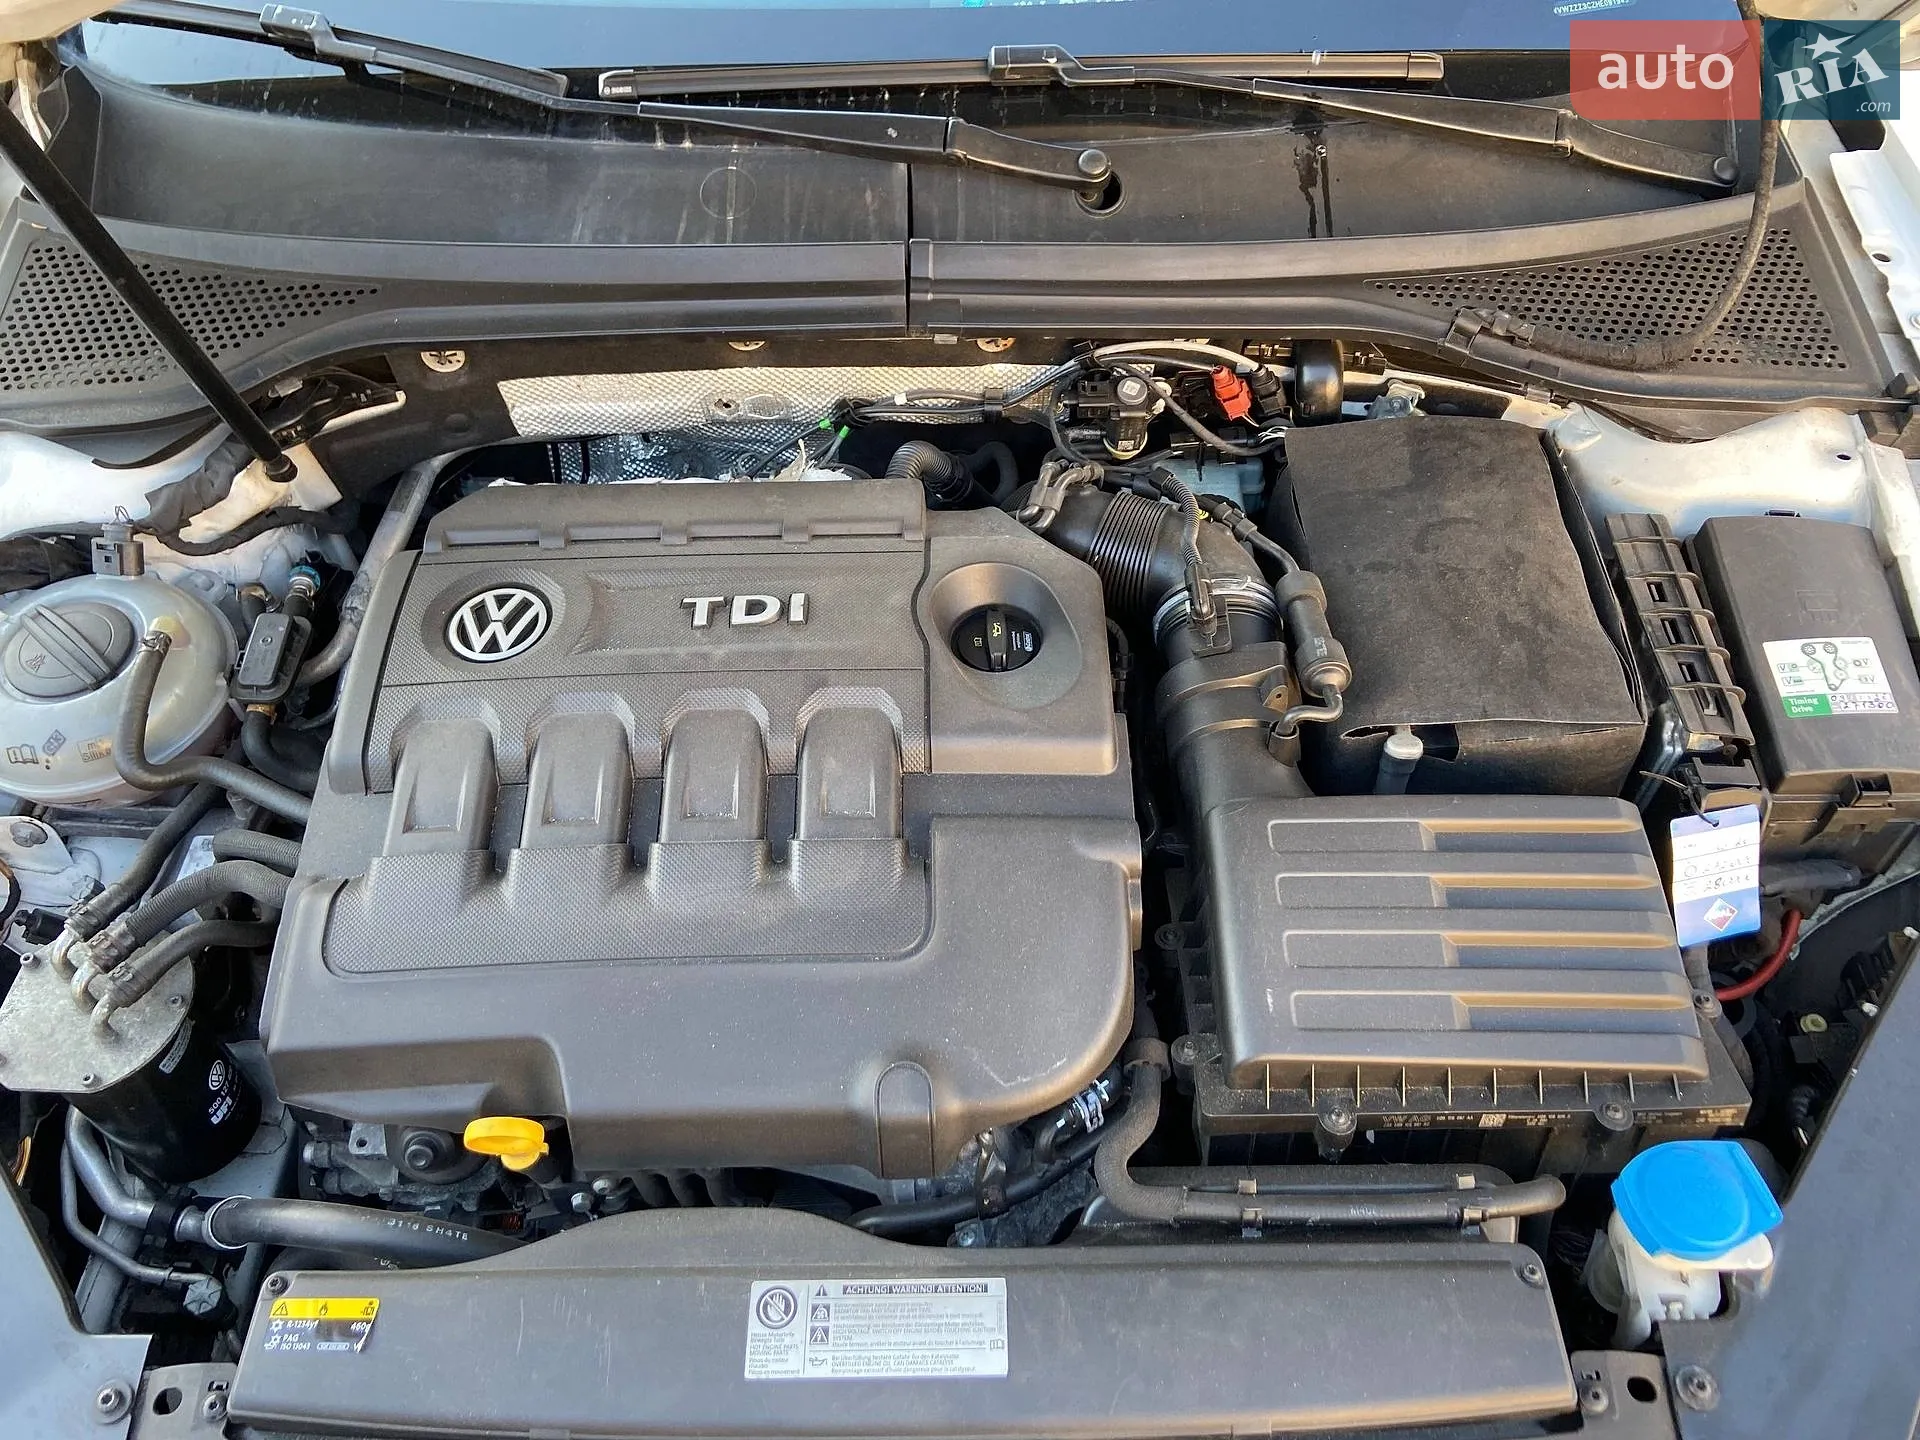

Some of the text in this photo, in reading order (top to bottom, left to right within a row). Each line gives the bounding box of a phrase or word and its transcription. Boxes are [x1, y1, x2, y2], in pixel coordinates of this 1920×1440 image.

[681, 593, 810, 629] TDI
[210, 1096, 233, 1124] UFI
[845, 1284, 986, 1294] ACHTUNG! WARNING! ATTENTION!
